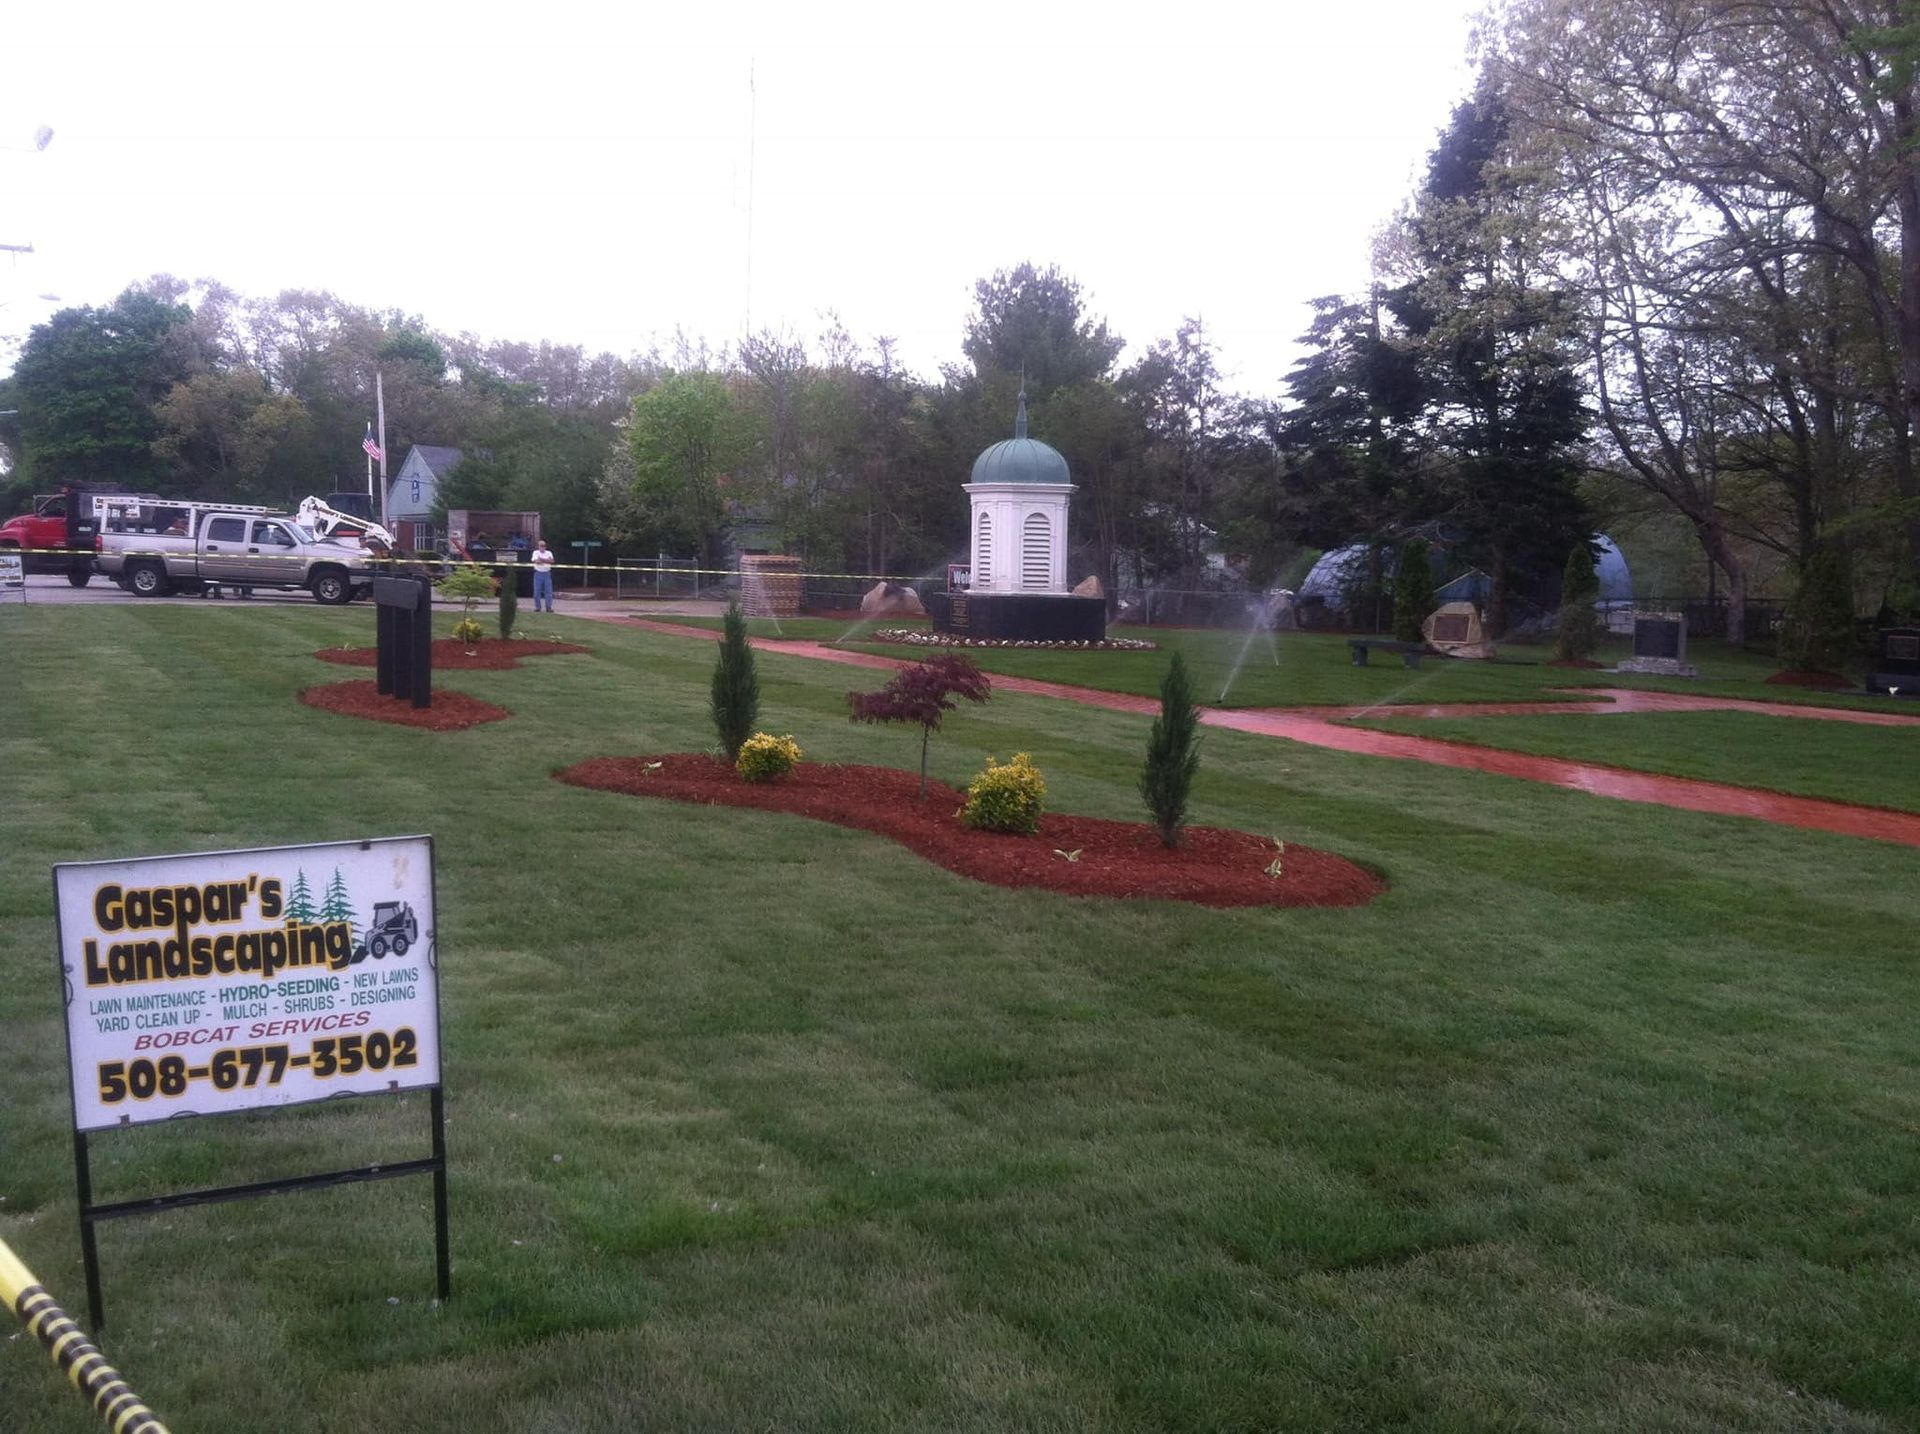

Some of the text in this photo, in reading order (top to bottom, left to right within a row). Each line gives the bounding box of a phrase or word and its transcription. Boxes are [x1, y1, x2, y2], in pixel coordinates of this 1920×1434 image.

[953, 570, 971, 584] Wel
[94, 874, 282, 942] Gaspar's
[84, 920, 352, 987] Landscaping
[89, 998, 122, 1016] LAWN
[126, 990, 207, 1012] MAINTENANCE
[219, 976, 340, 1003] HYDRO-SEEDING
[353, 972, 379, 989] NEW
[382, 967, 419, 986] LAWNS
[96, 1016, 130, 1033] YARD
[135, 1011, 179, 1030] CLEAN
[183, 1009, 201, 1025] UP
[223, 1002, 268, 1021] MULCH
[284, 995, 335, 1014] SHRUBS
[350, 985, 416, 1007] DESIGNING
[134, 1011, 372, 1050] BOBCAT SERVICES
[98, 1027, 418, 1104] 508-677-3502
